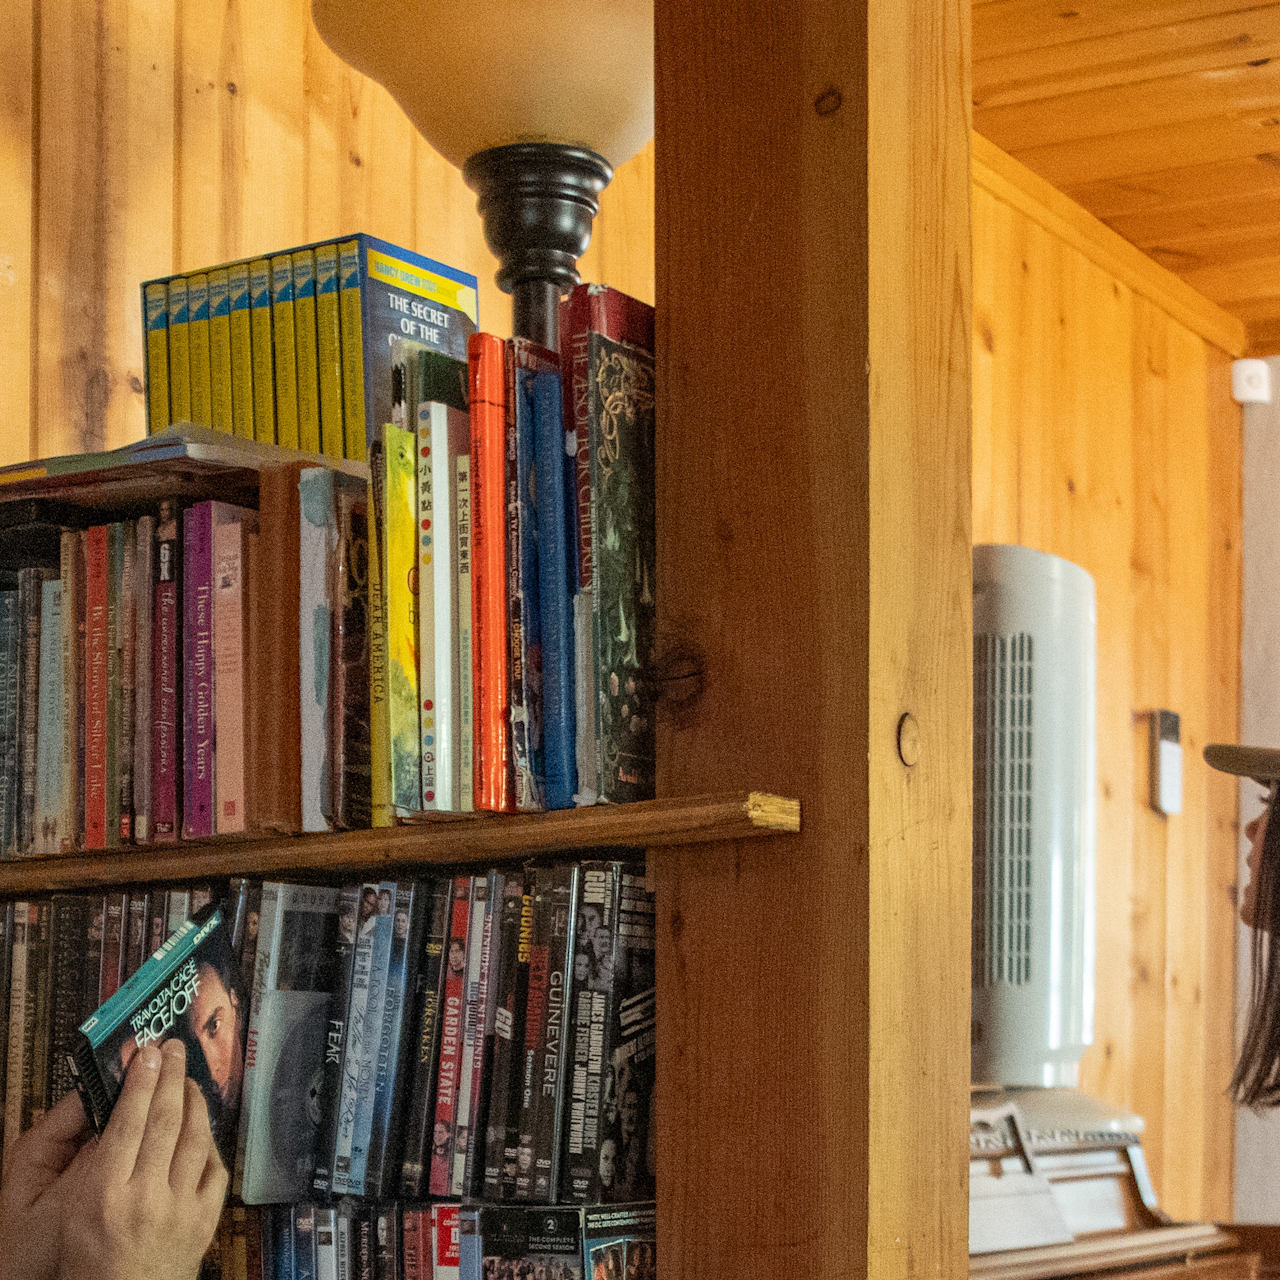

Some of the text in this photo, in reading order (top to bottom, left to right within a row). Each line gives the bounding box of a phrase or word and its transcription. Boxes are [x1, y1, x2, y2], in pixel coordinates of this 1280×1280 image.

[388, 292, 450, 329] THE SECRET
[401, 317, 418, 336] OF
[419, 322, 441, 345] THE
[571, 330, 589, 365] THE
[576, 440, 592, 480] FOR
[578, 484, 595, 595] CHILDREN
[371, 583, 385, 705] DEAR AMERICA
[6, 663, 18, 718] NORA
[90, 651, 104, 700] Shores
[194, 583, 210, 780] These Happy Golden Years
[90, 721, 104, 761] Silver
[583, 871, 605, 904] GUN
[516, 894, 533, 964] GOONIES
[129, 957, 198, 1031] TRAVOLTA/CAGE
[135, 973, 202, 1049] FACE/OFF
[577, 991, 592, 1026] CARRIE
[591, 991, 606, 1022] JAMES
[325, 1019, 343, 1065] FEAR
[375, 986, 396, 1094] FORGOTTEN
[420, 989, 436, 1064] FORSAKEN
[542, 970, 566, 1098] GUINEVERE
[574, 1027, 590, 1063] FISHER
[437, 996, 460, 1106] GARDEN STATE
[524, 1050, 536, 1086] Season
[522, 1088, 532, 1108] One
[572, 1064, 588, 1101] JOHNNY
[585, 1075, 602, 1117] KIRSTEN
[583, 1118, 599, 1150] DUNST
[339, 1230, 347, 1259] ALFRED
[545, 1218, 557, 1232] 2
